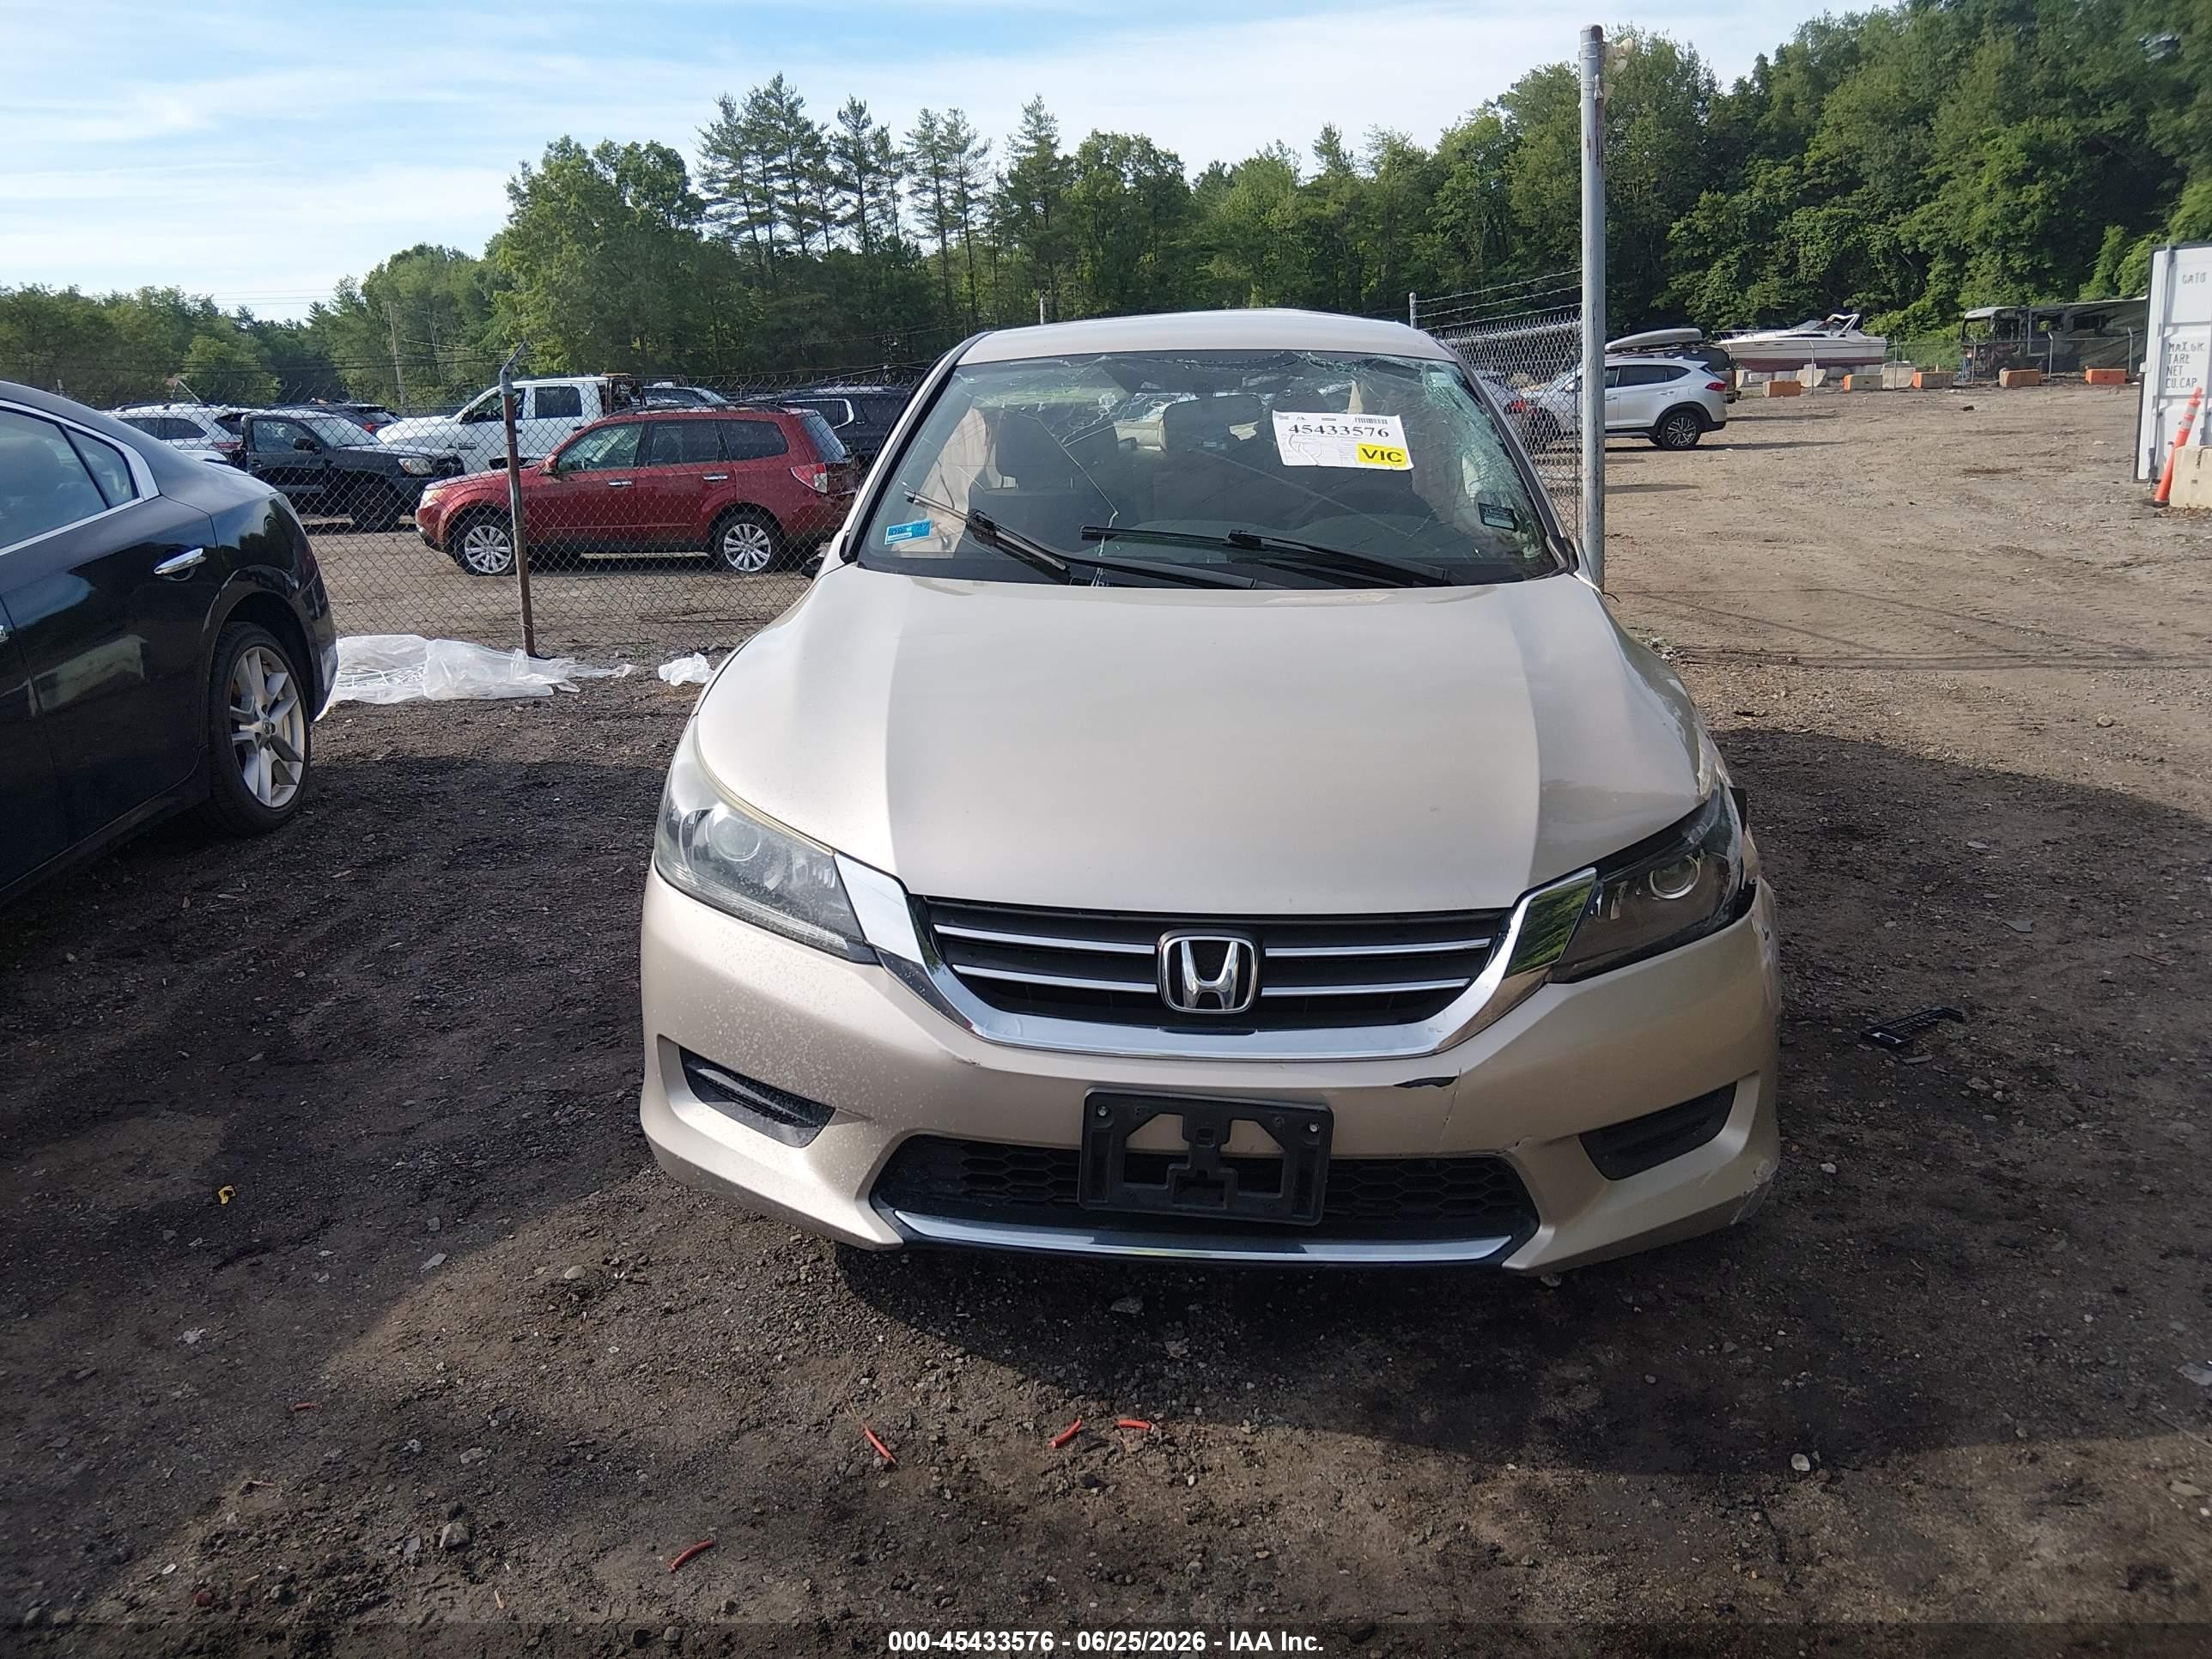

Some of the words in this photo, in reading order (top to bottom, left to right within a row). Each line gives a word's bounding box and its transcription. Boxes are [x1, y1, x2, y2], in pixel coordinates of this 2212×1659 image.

[2168, 353, 2191, 364] TARE
[2166, 365, 2183, 376] NET
[1288, 424, 1389, 438] 45433576
[1361, 447, 1402, 462] VIC
